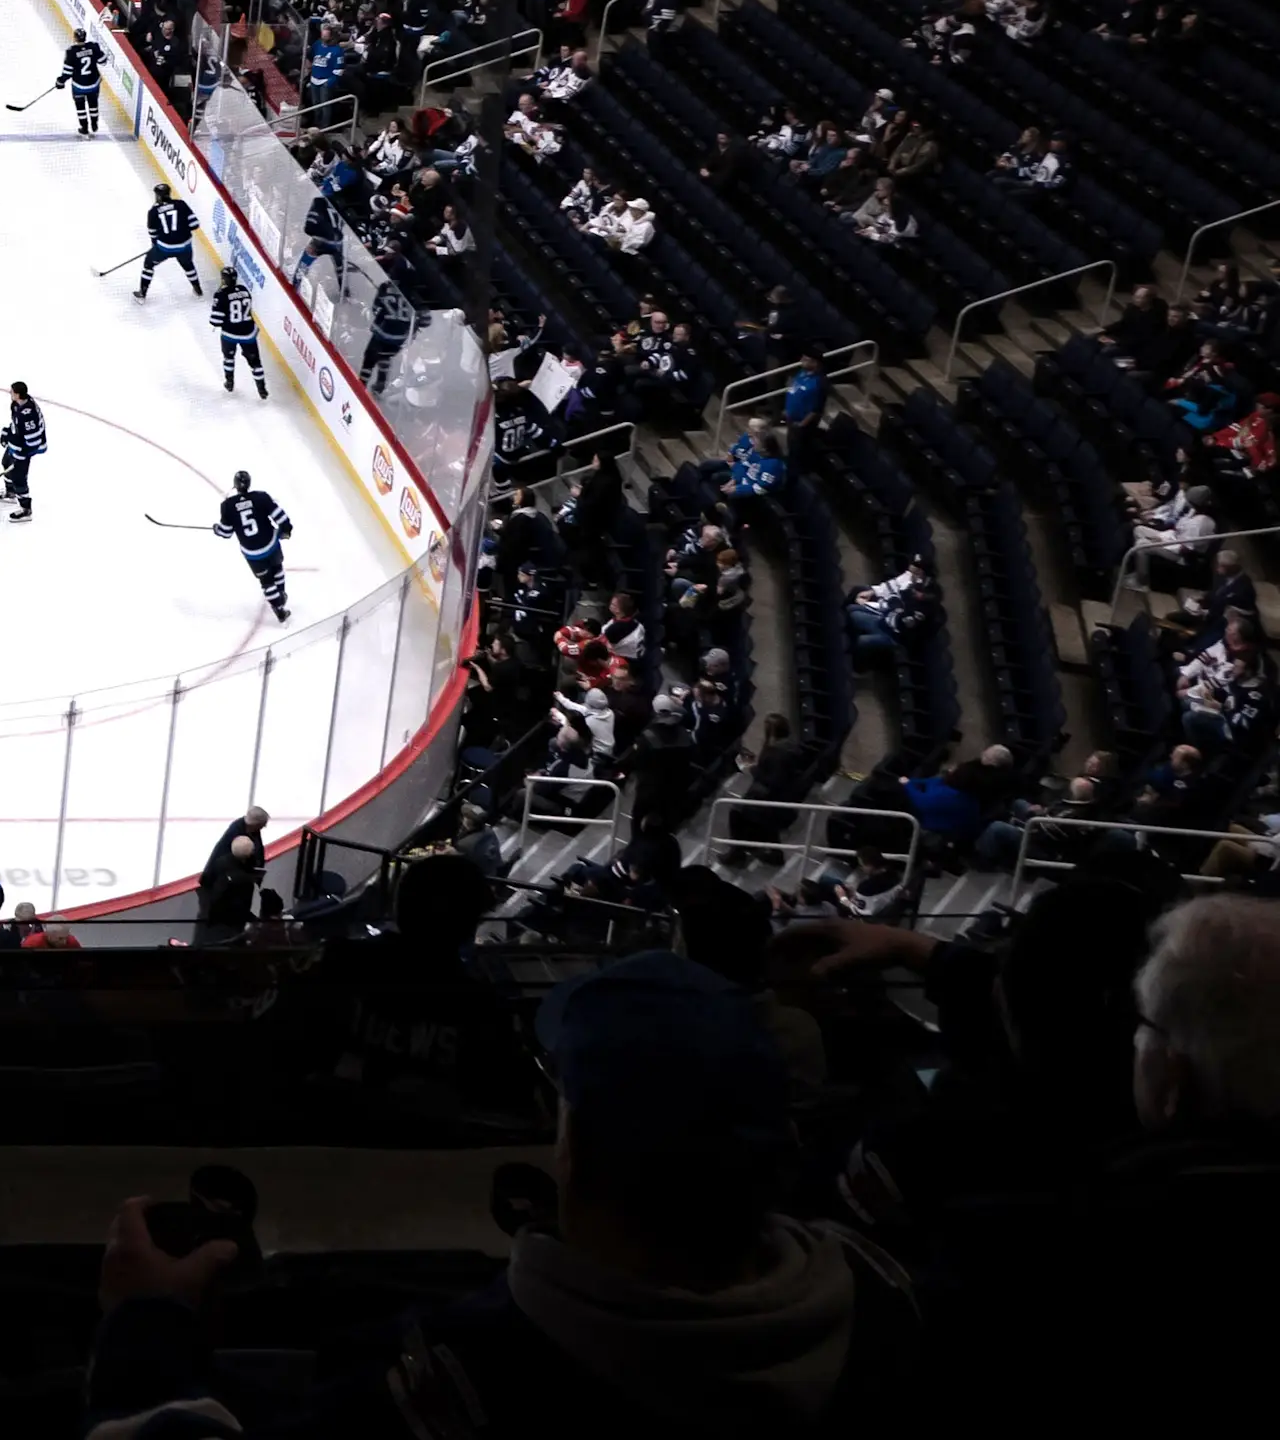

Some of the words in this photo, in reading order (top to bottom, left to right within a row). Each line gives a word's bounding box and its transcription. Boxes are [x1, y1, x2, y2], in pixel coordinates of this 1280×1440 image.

[80, 56, 91, 76] 2
[146, 105, 186, 181] Payworks
[158, 210, 179, 234] 17
[230, 298, 251, 323] 82
[283, 316, 292, 336] GO
[291, 334, 317, 375] CANADA
[25, 420, 37, 430] 55
[240, 509, 259, 536] 5
